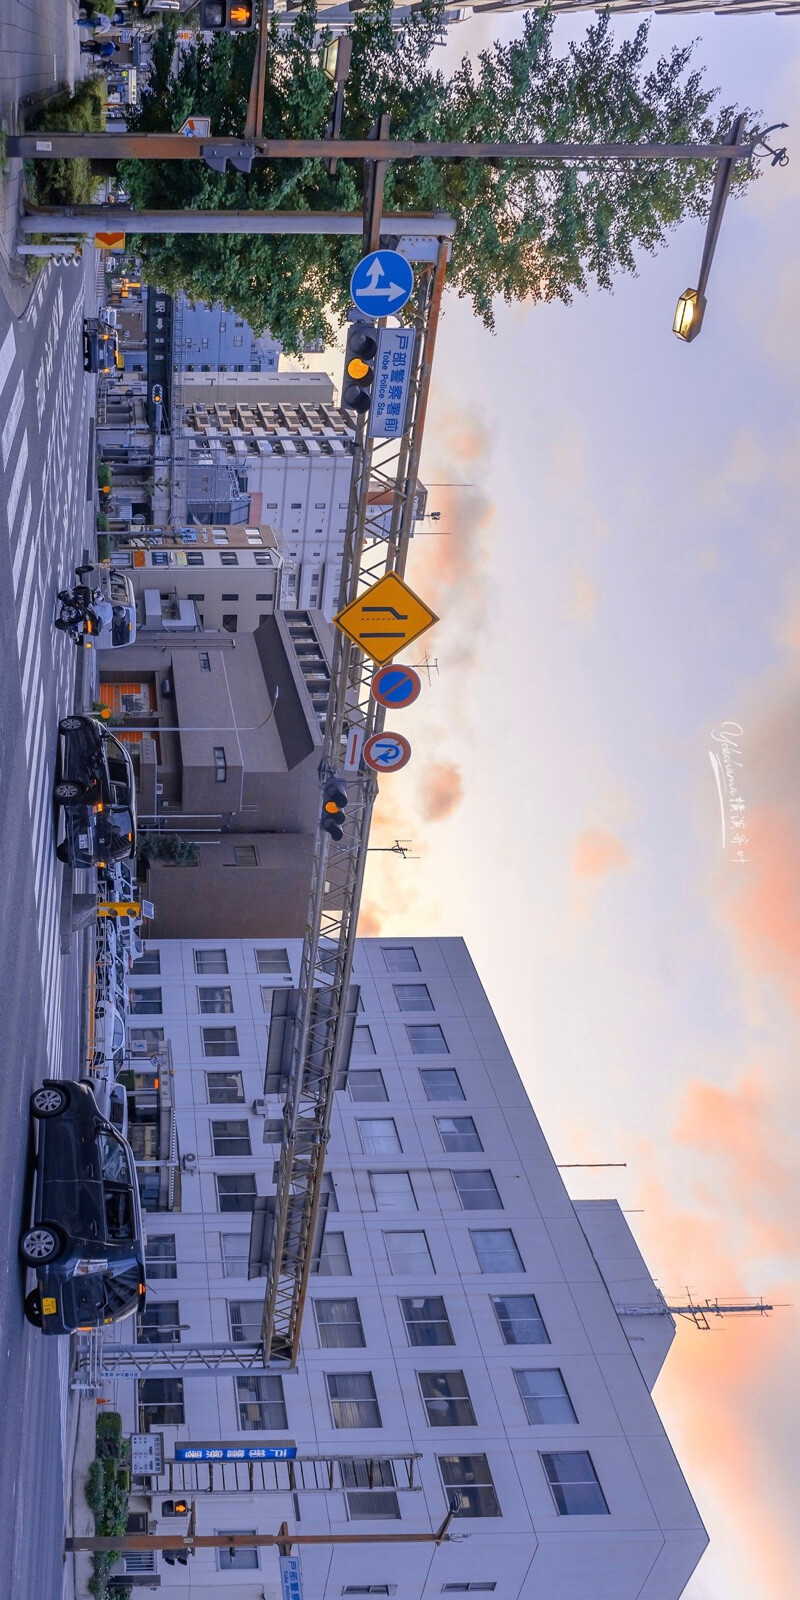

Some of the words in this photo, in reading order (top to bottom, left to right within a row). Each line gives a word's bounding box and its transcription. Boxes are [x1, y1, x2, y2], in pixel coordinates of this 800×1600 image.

[382, 350, 391, 370] Tobe
[378, 374, 388, 398] Police
[384, 335, 409, 431] 戸部警察署前
[377, 402, 385, 418] Sta.
[185, 1449, 287, 1458] 戸部警察署
